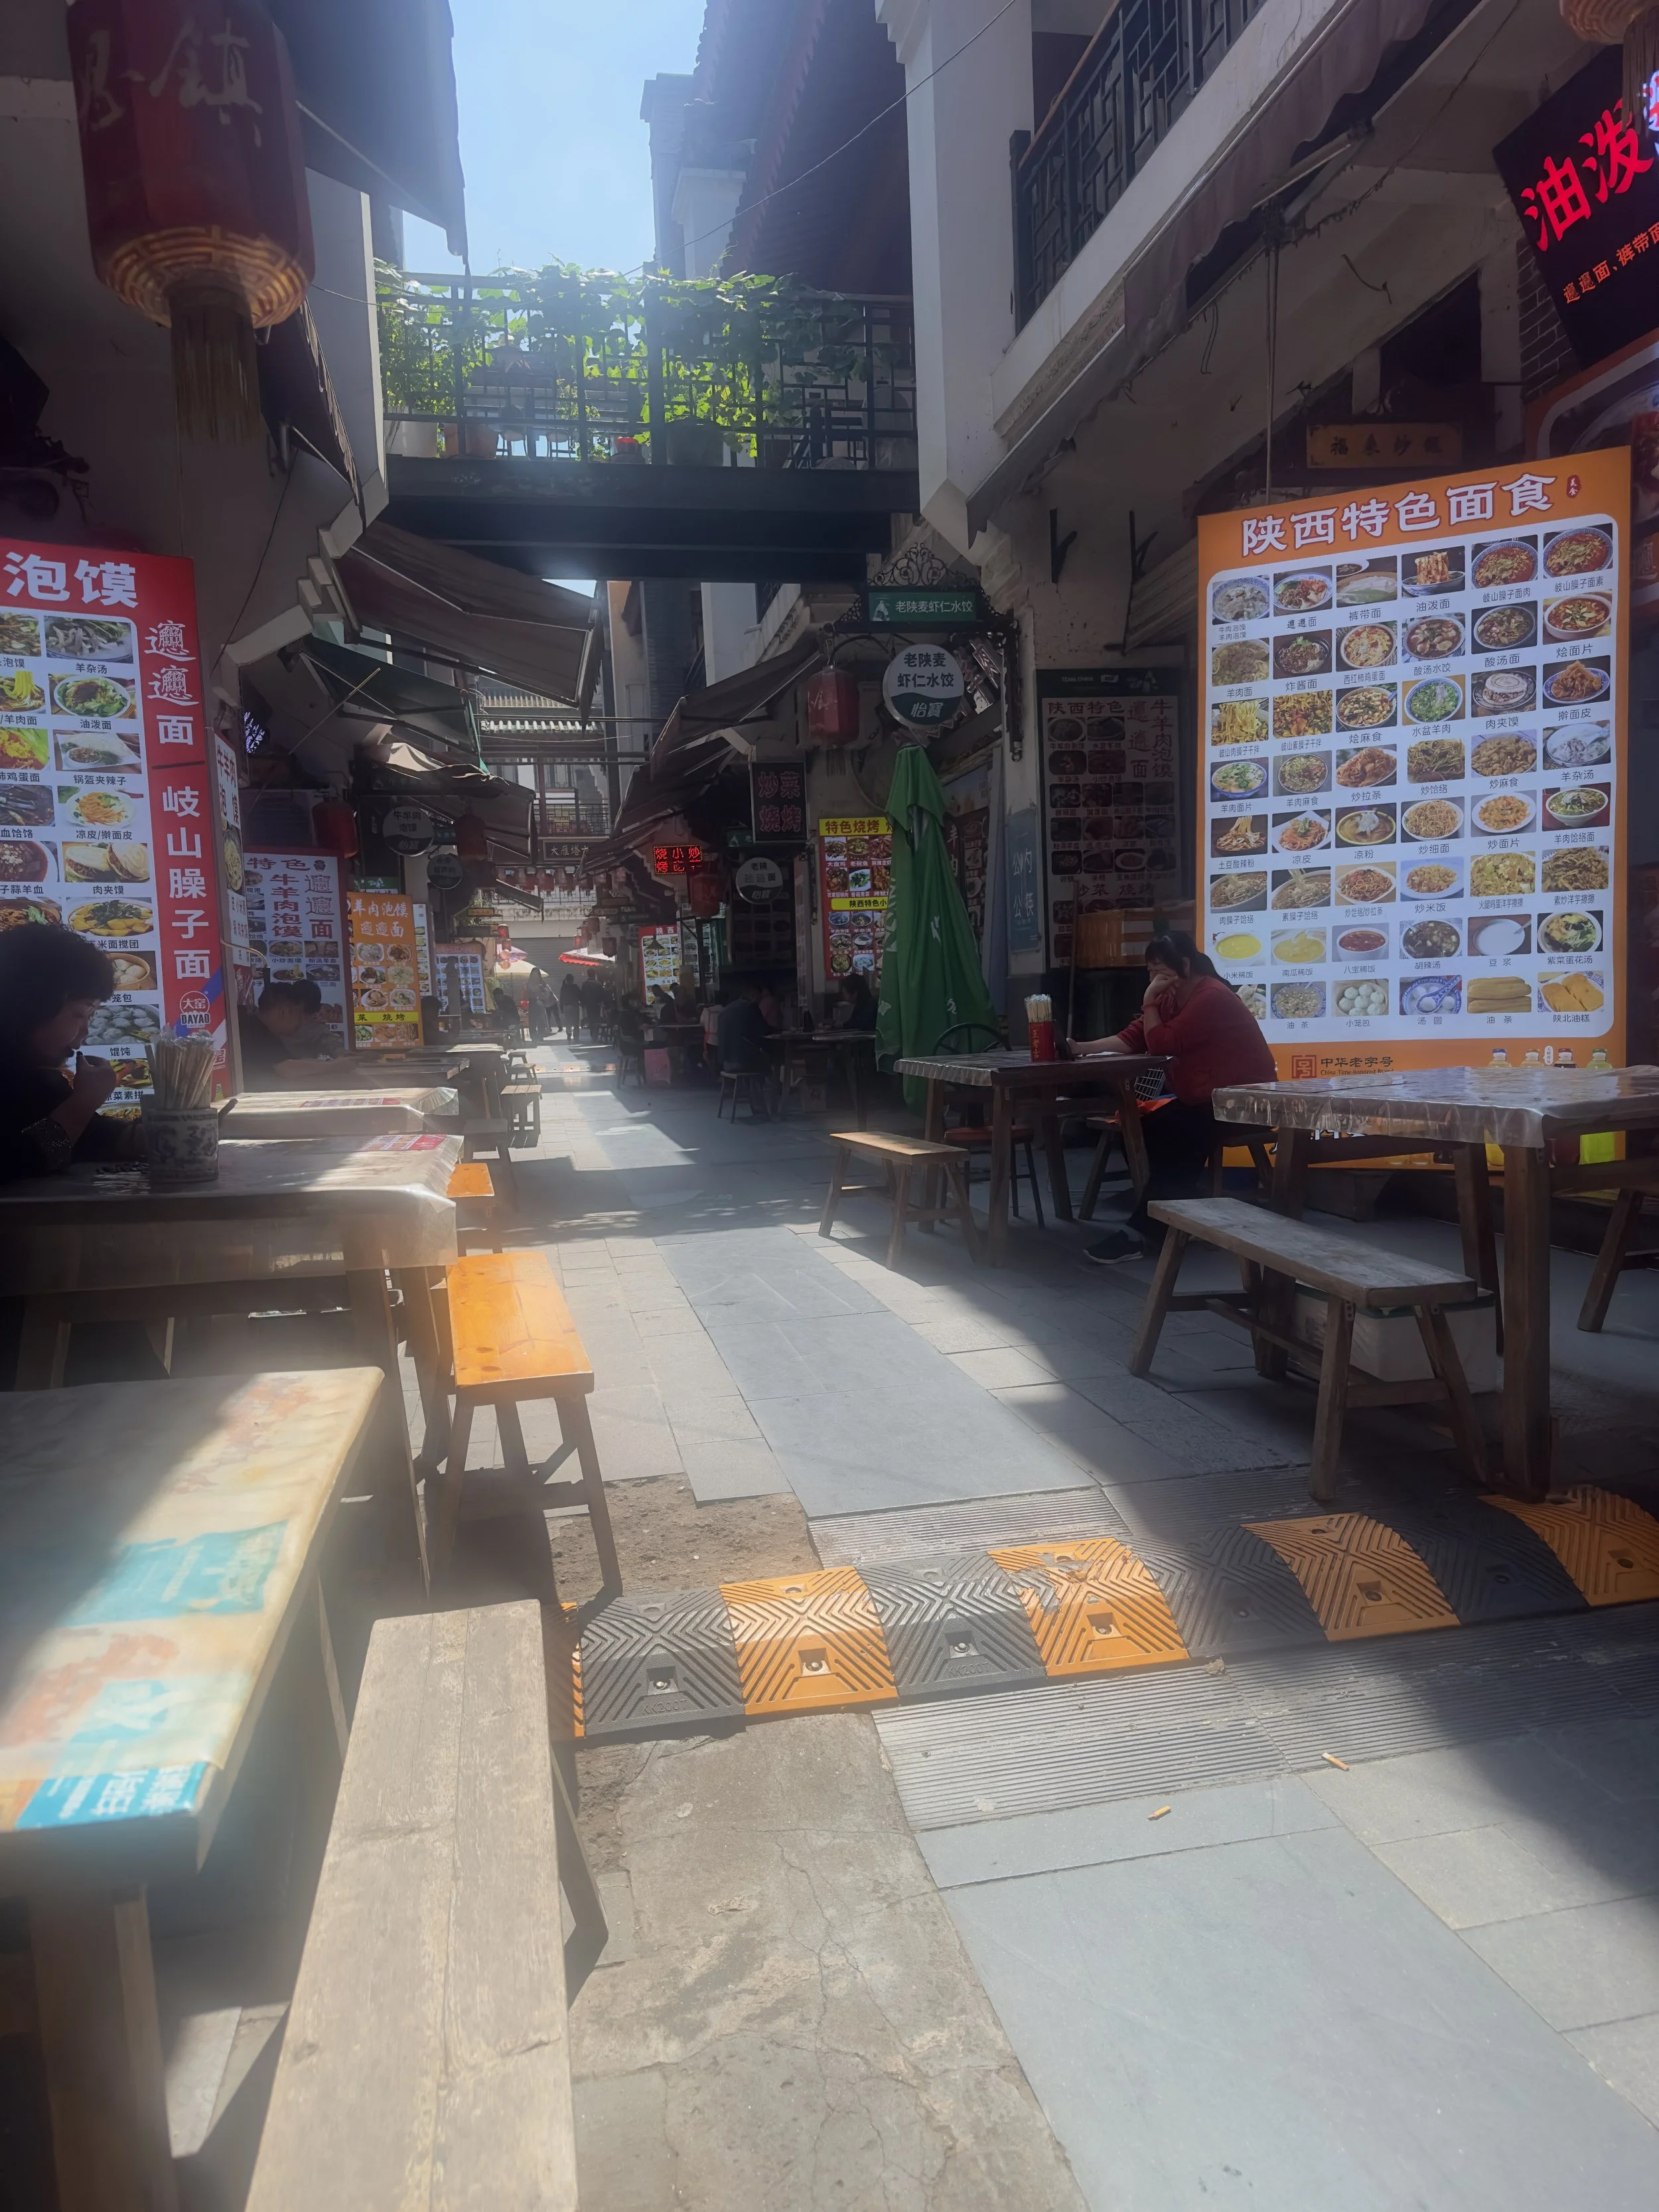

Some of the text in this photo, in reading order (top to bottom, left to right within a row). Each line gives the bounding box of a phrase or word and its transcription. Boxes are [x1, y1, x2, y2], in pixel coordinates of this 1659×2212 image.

[1521, 98, 1654, 252] 油泼
[1241, 473, 1557, 556] 陕西特色面食
[3, 552, 138, 608] 泡馍
[1555, 576, 1603, 593] 岐山臊子面素
[1482, 587, 1530, 603] 岐山臊子面肉
[896, 601, 973, 613] 老陕麦虾仁水饺
[1416, 599, 1450, 612] 油泼面
[1348, 608, 1381, 621] 裤带面
[1556, 644, 1593, 658] 烩面片
[0, 657, 25, 668] 泡馍
[904, 652, 946, 667] 老陕麦
[1484, 654, 1520, 668] 酸汤面
[76, 663, 107, 674] 羊杂汤
[1413, 663, 1451, 676] 酸汤水饺
[897, 673, 954, 688] 虾仁水饺
[1344, 670, 1385, 684] 西红柿鸡蛋面
[1285, 679, 1317, 691] 炸酱面
[1227, 687, 1252, 698] 羊肉面
[1048, 701, 1125, 715] 陕西特色
[1558, 707, 1591, 721] 擀面皮
[80, 719, 111, 730] 油泼面
[1486, 717, 1519, 729] 肉夹馍
[1412, 724, 1451, 737] 水盆羊肉
[1151, 699, 1174, 778] 牛羊肉泡馍
[1349, 732, 1382, 743] 烩麻食
[1219, 745, 1260, 758] 岐山肉臊子干拌
[218, 745, 236, 788] 牛羊肉
[74, 775, 126, 785] 锅盔夹辣子
[1561, 769, 1594, 782] 羊杂汤
[758, 771, 800, 798] 炒菜
[1489, 777, 1518, 788] 炒麻食
[1287, 796, 1319, 807] 羊肉麻食
[1351, 790, 1381, 802] 炒拉条
[1221, 803, 1252, 813] 羊肉面片
[759, 805, 802, 832] 烧烤
[826, 820, 879, 834] 特色烧烤
[76, 830, 132, 840] 凉皮/擀面皮
[1419, 844, 1449, 855] 炒细面
[1488, 838, 1520, 849] 炒面片
[1292, 855, 1311, 865] 凉皮
[1354, 849, 1374, 859] 凉粉
[247, 857, 310, 871] 特色
[1218, 859, 1254, 869] 土豆酸辣粉
[163, 786, 210, 980] 岐山臊子面
[93, 885, 124, 895] 肉夹馍
[269, 874, 303, 938] 牛羊肉泡馍
[353, 899, 408, 919] 羊肉泡馍
[849, 899, 887, 908] 陕西特色小
[1415, 903, 1446, 913] 炒米饭
[91, 940, 139, 950] 米面搅团
[1415, 961, 1441, 970] 胡辣汤
[1547, 955, 1593, 965] 紫菜蛋花汤
[1282, 968, 1313, 977] 南瓜稀饭
[1344, 965, 1376, 974] 八宝稀饭
[182, 998, 205, 1009] 大窑
[181, 1013, 210, 1025] DAYAO
[1553, 1014, 1590, 1023] 陕北油糕
[110, 1048, 130, 1057] 馄饨
[1321, 1057, 1393, 1067] 中华老字号
[642, 1700, 687, 1716] KK200T
